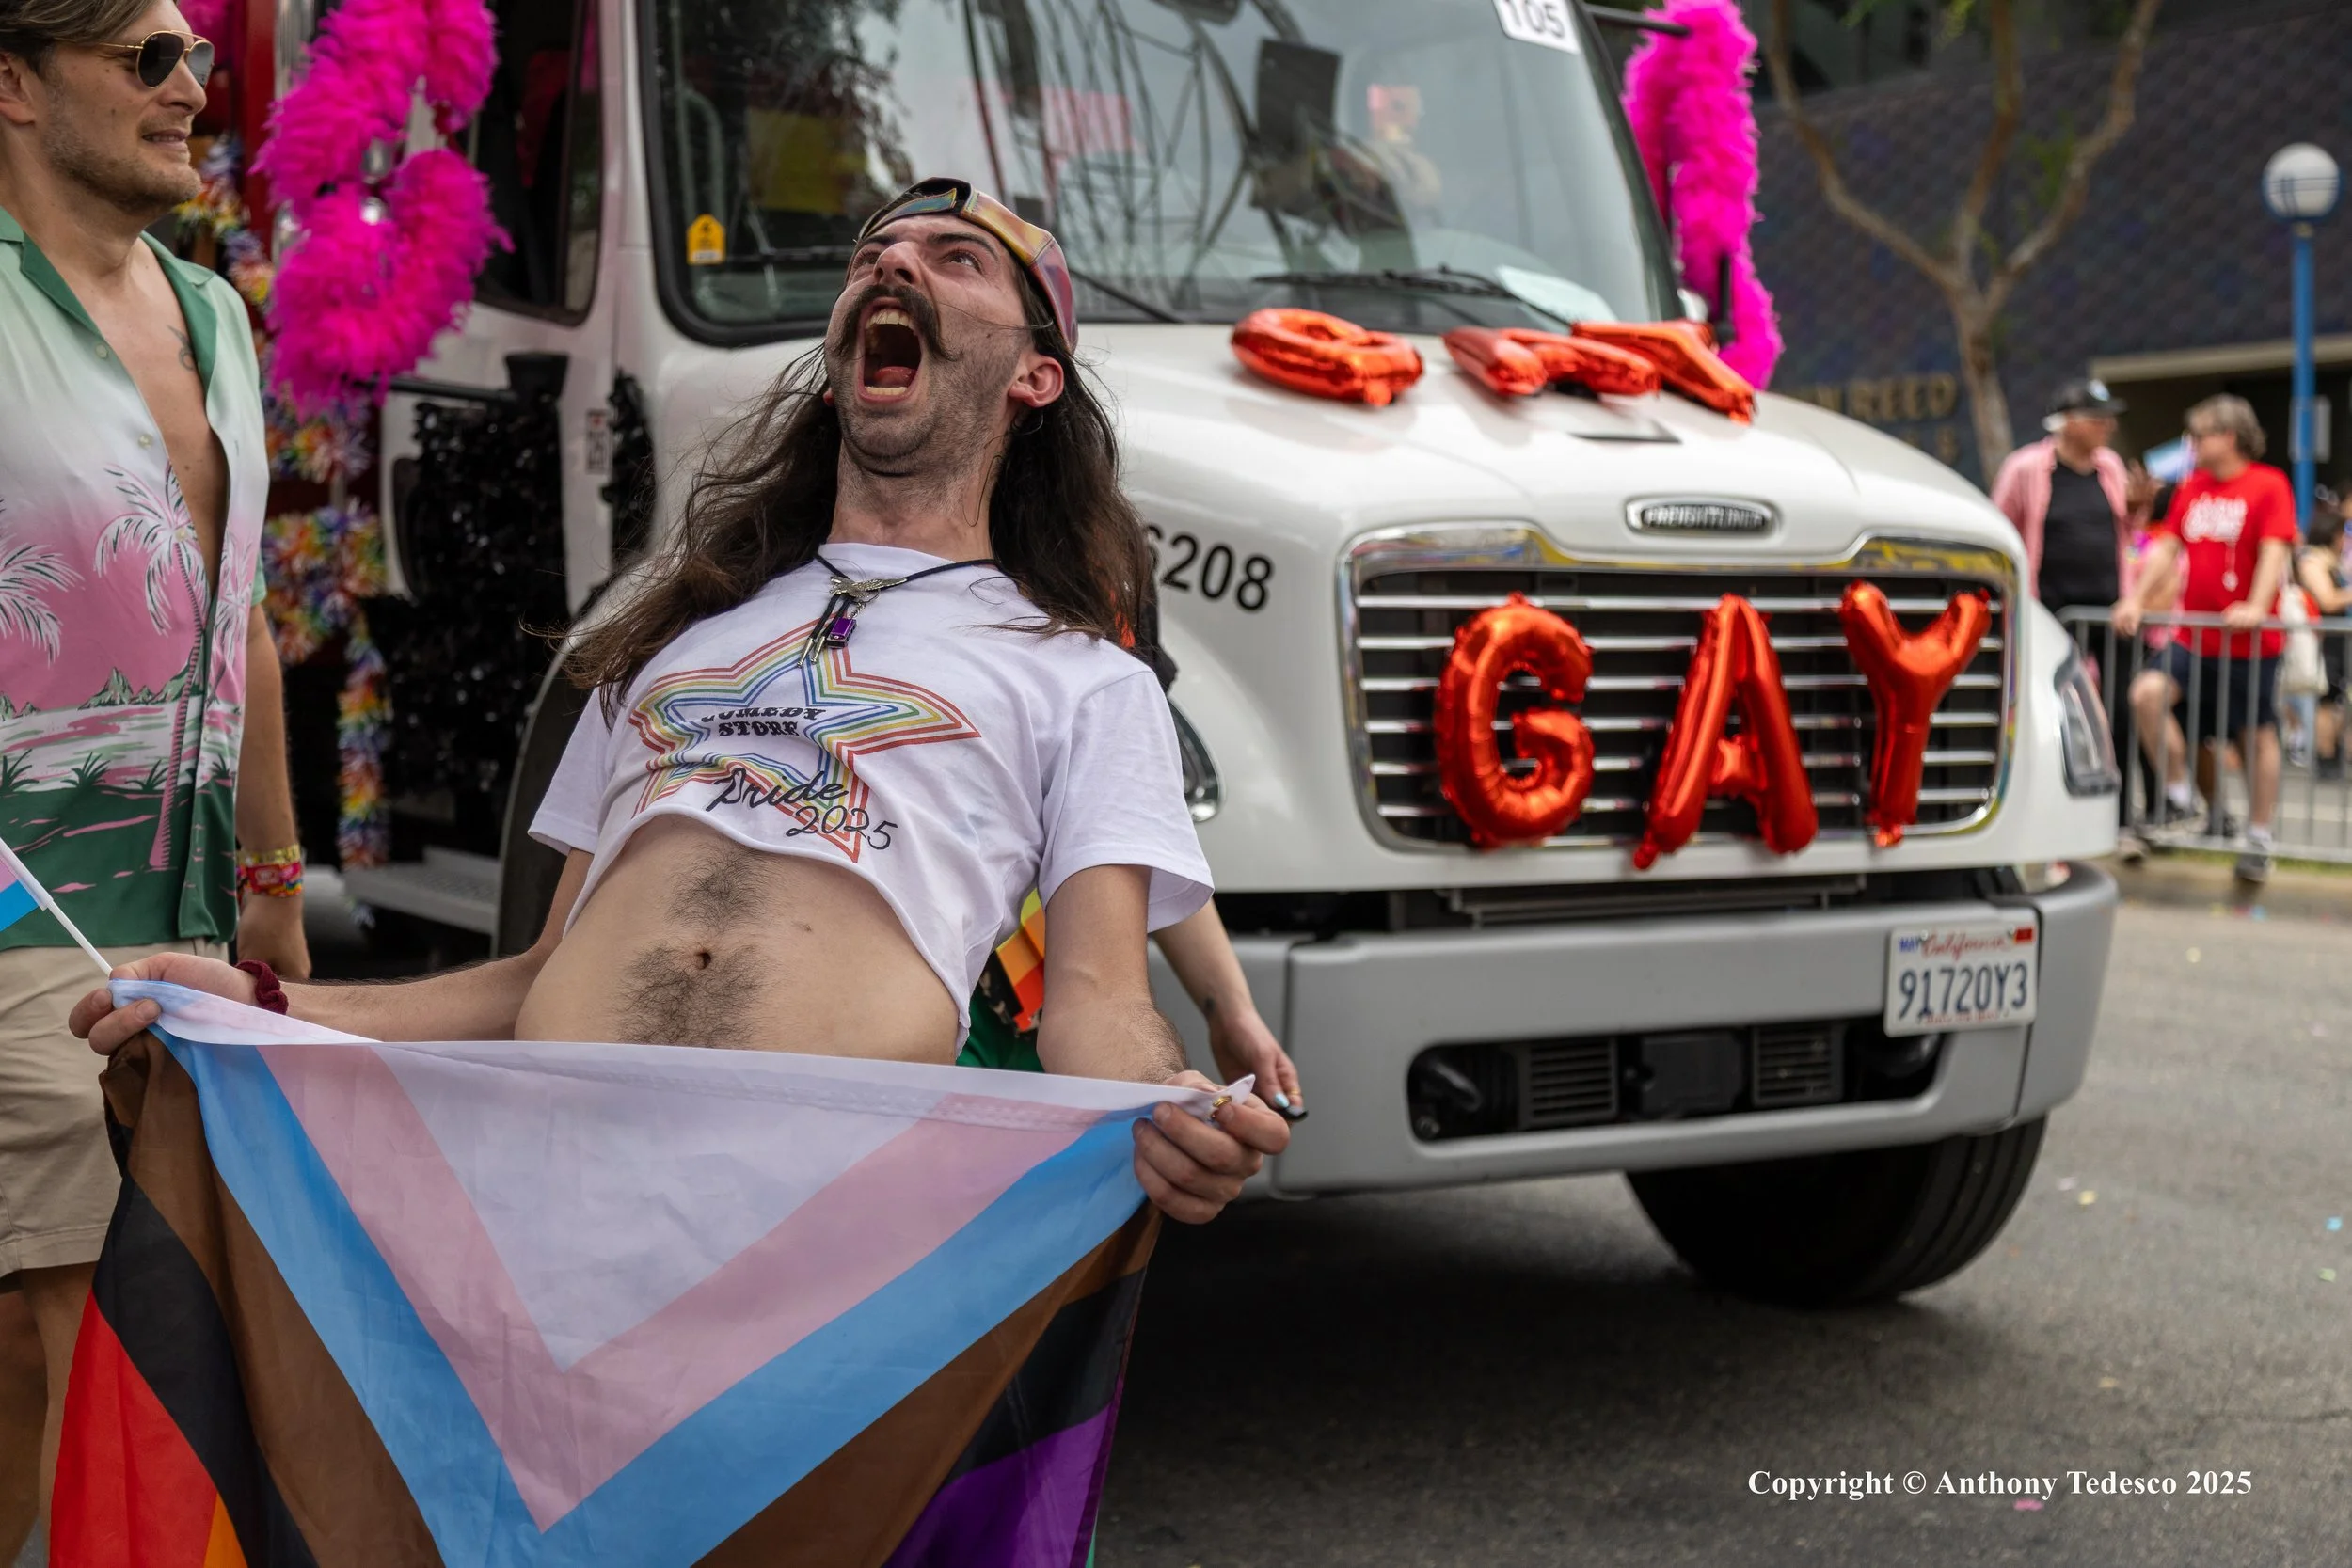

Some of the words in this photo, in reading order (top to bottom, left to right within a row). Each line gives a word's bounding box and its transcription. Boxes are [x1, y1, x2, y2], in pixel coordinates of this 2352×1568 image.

[718, 721, 801, 736] STORE
[1435, 579, 1992, 870] GAY
[706, 768, 849, 812] Pride
[786, 805, 898, 850] 2025
[1922, 927, 2010, 961] California
[1899, 961, 2028, 1022] 91720Y3
